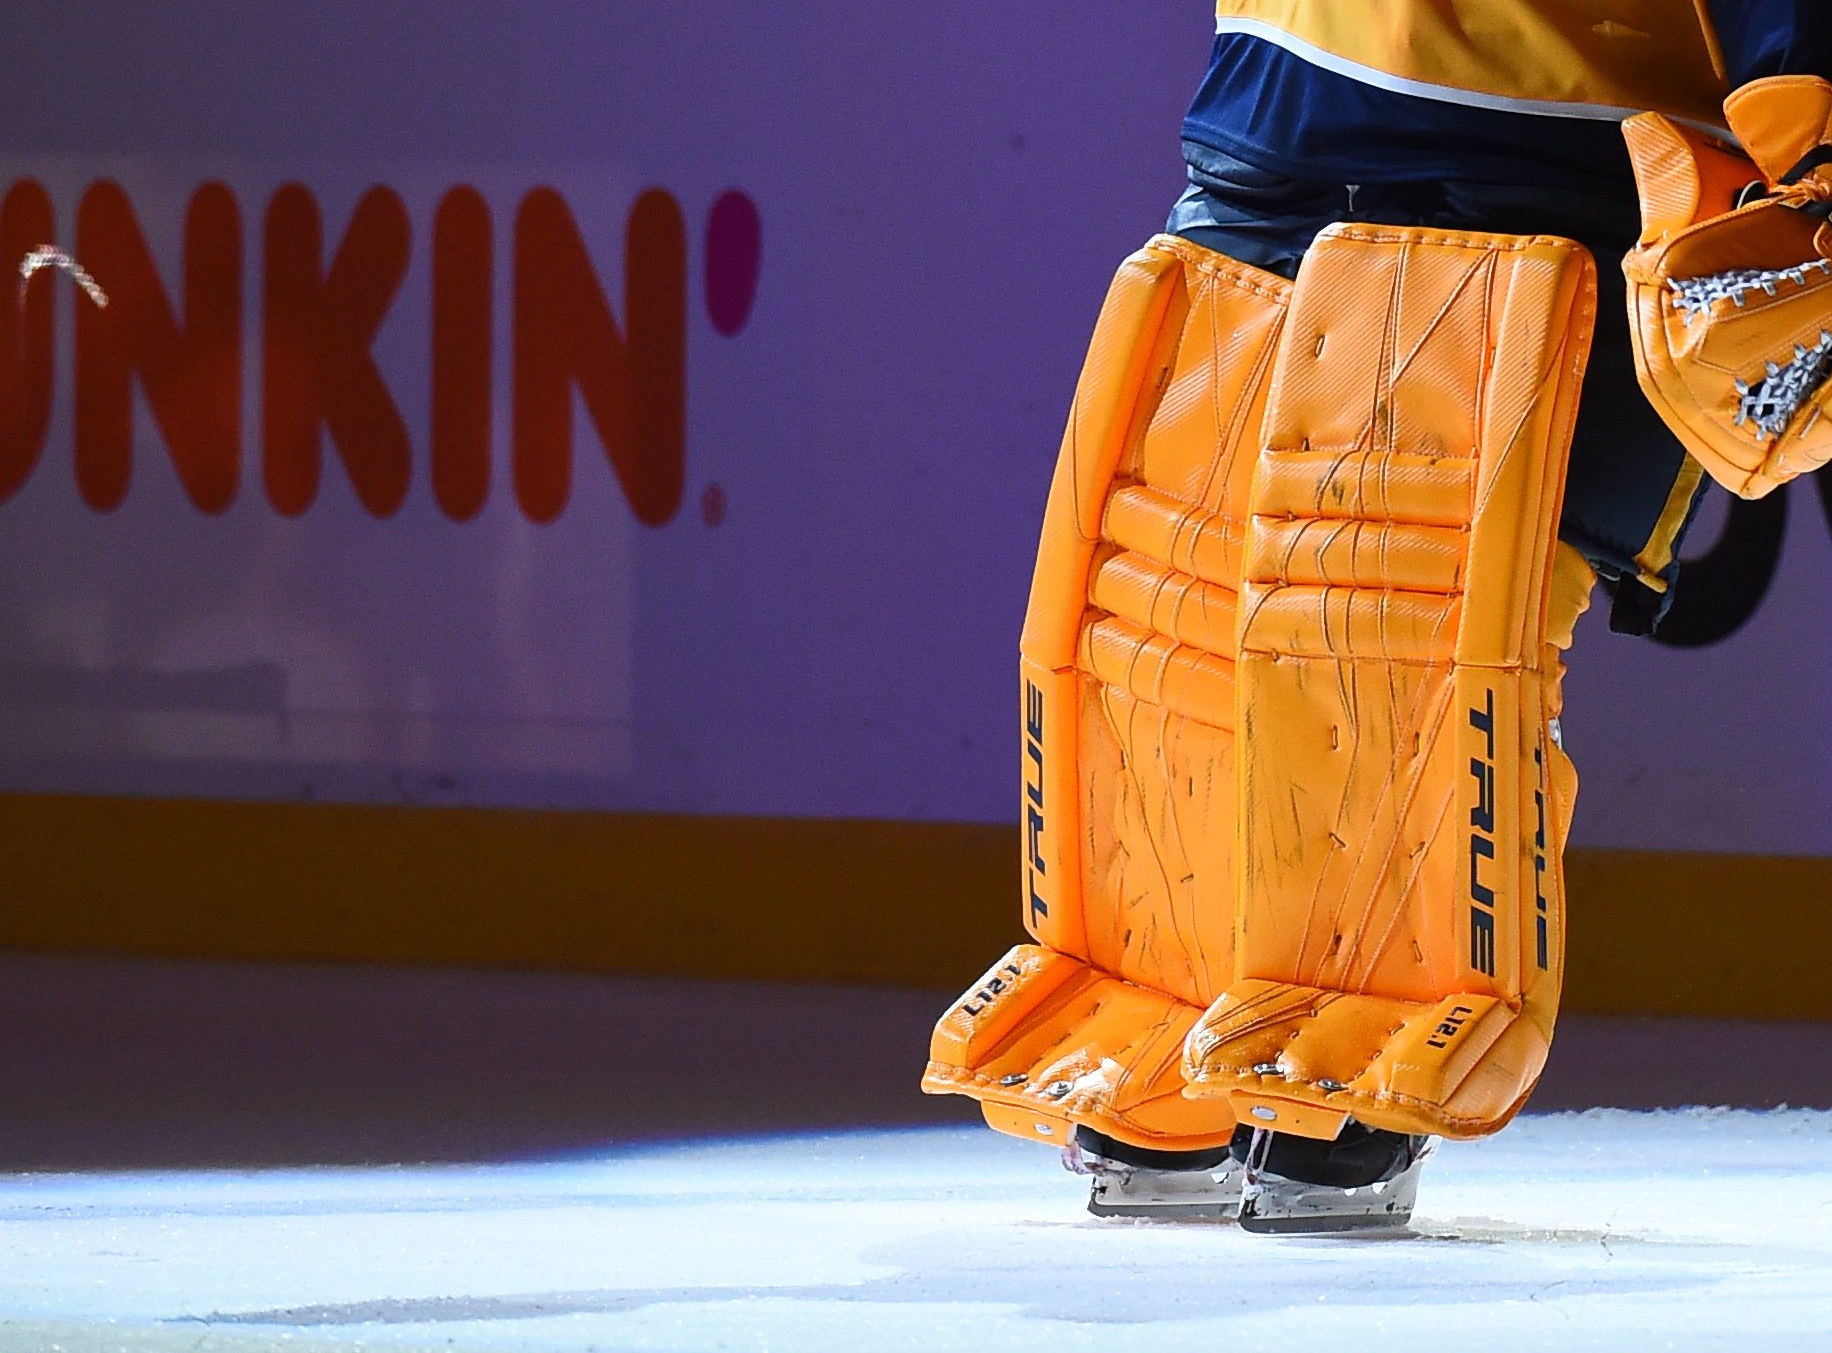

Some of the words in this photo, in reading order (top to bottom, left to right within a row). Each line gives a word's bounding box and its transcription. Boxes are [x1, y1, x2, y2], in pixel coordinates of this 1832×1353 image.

[1026, 678, 1049, 930] TRUE
[1469, 688, 1495, 978] TRUE
[1534, 727, 1548, 972] TRUE
[962, 964, 1021, 1016] L12.1
[1426, 1006, 1473, 1049] L12.1
